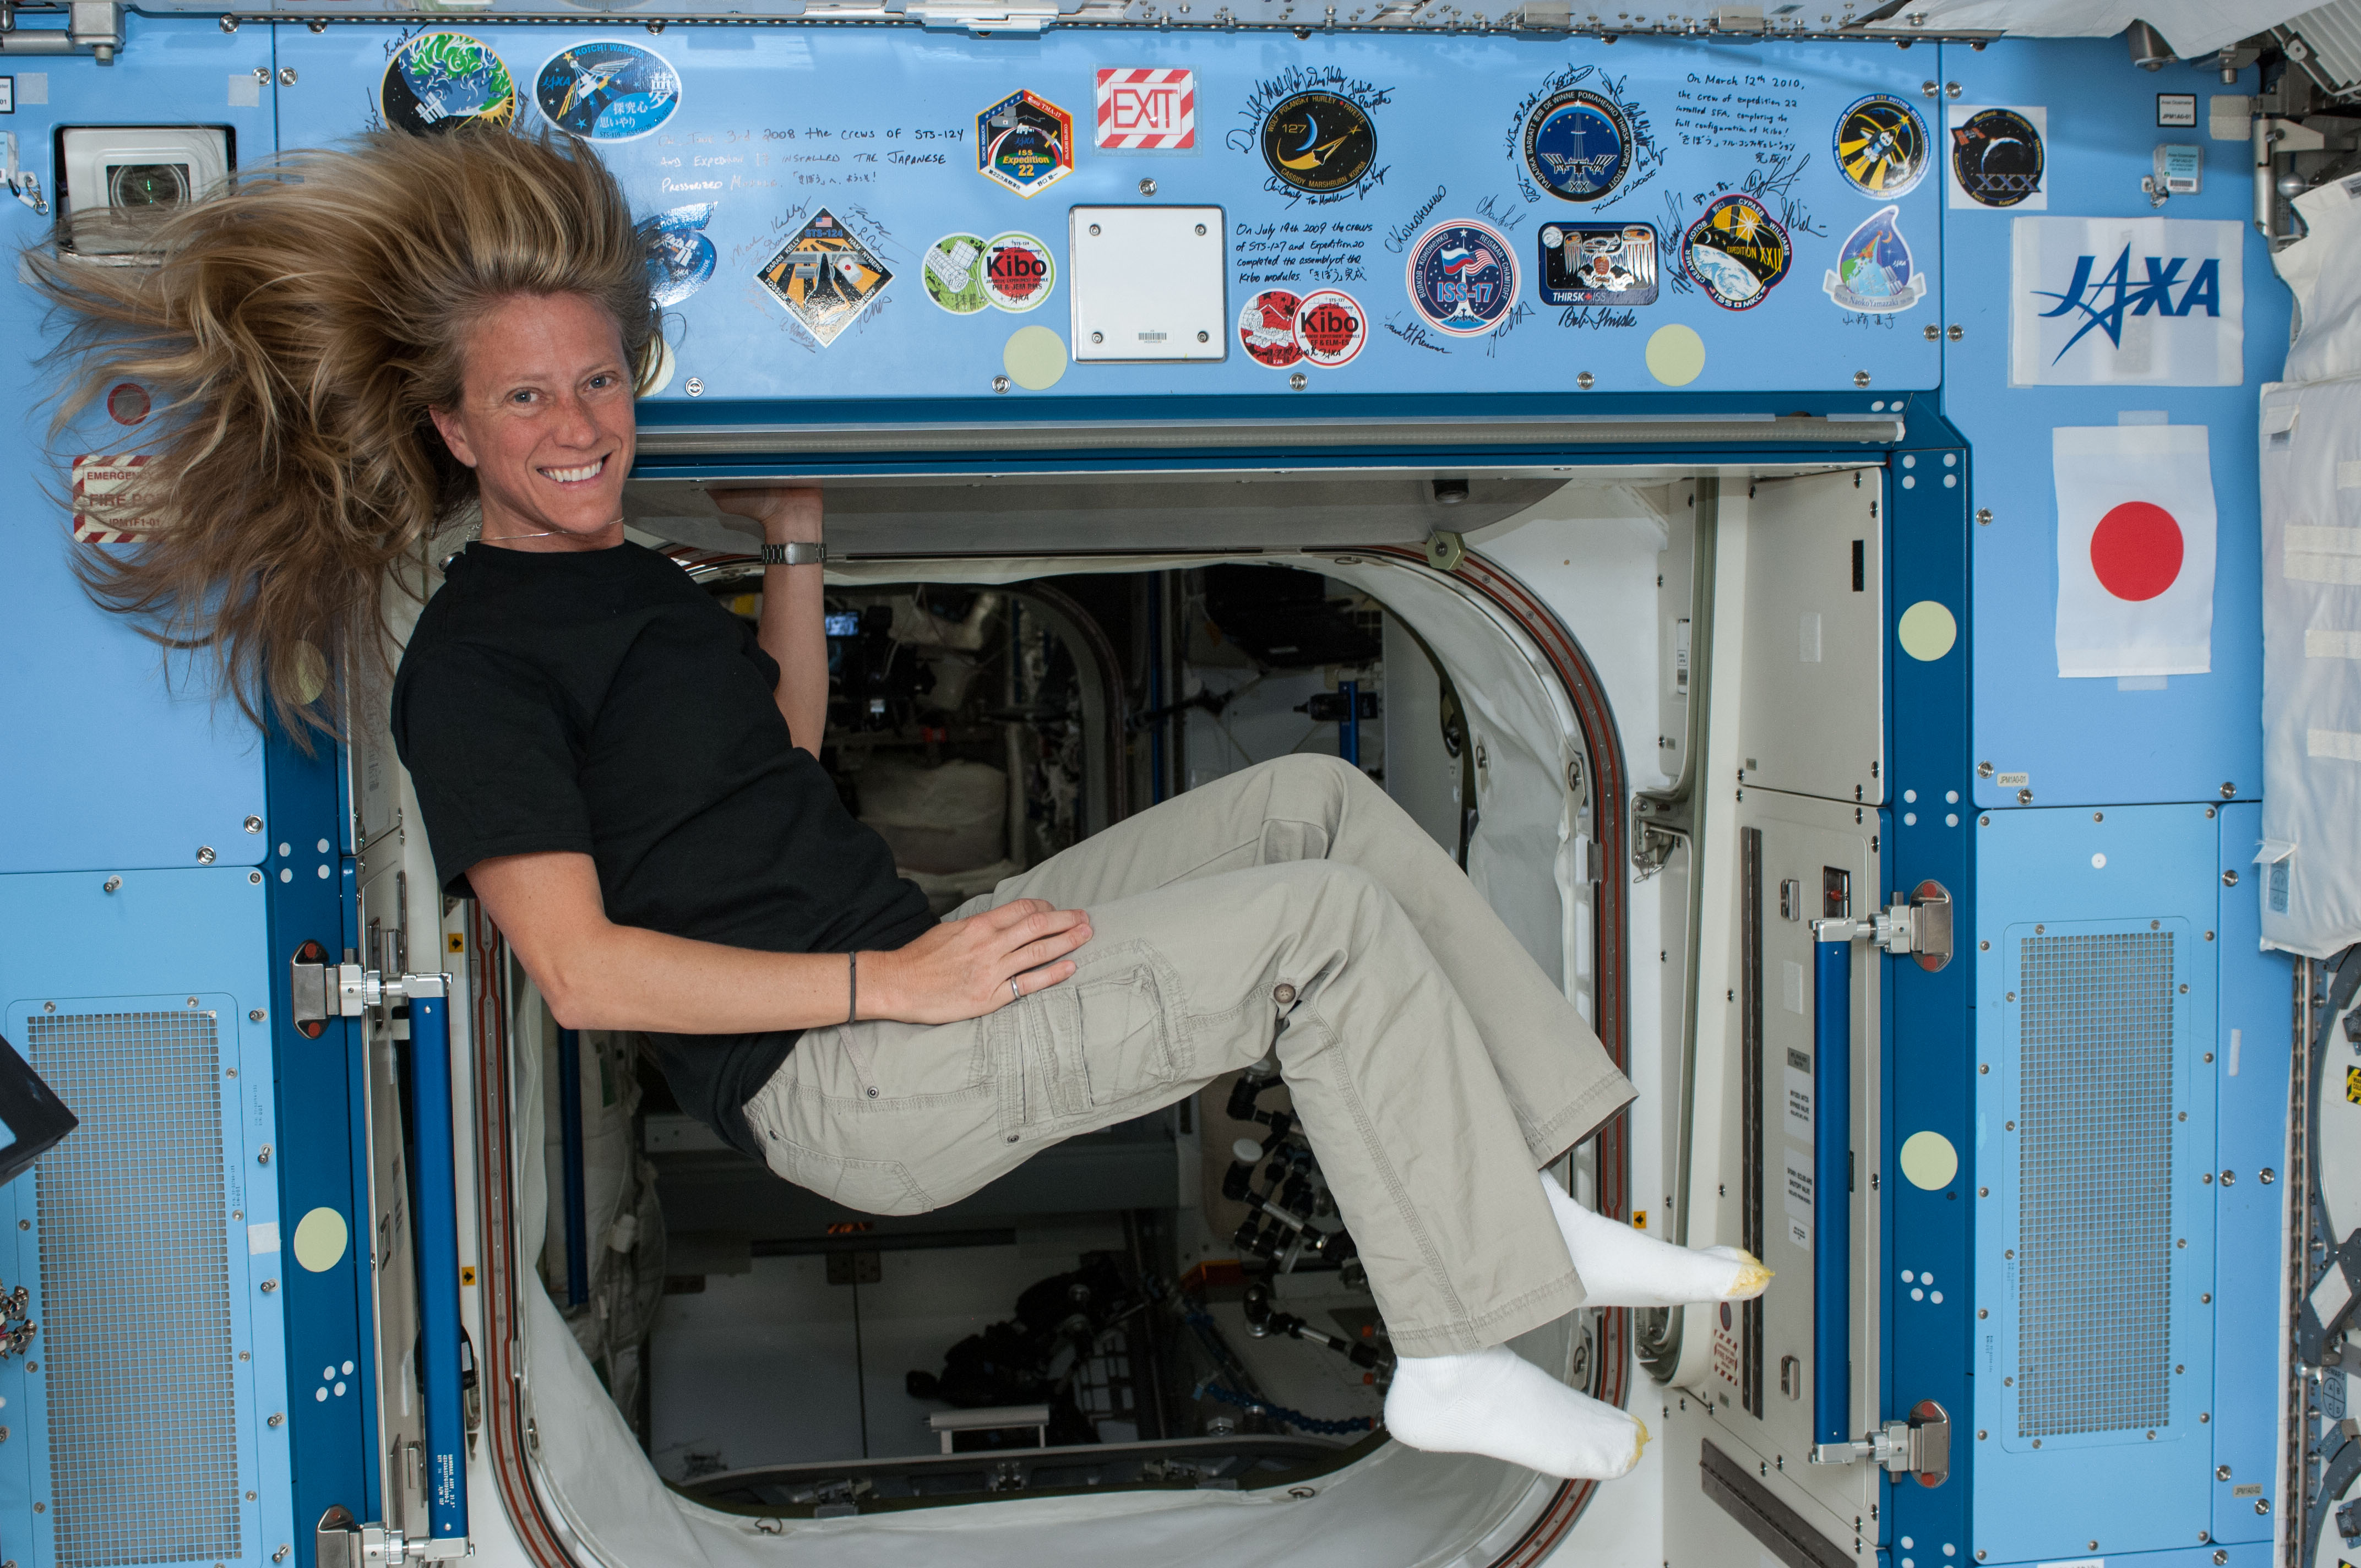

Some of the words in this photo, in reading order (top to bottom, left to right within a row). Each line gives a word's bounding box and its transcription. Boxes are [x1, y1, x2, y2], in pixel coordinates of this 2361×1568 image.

[575, 45, 607, 57] KOICHI
[610, 45, 644, 58] WAKATA
[540, 75, 570, 92] JAXA
[1687, 73, 1701, 83] On
[1705, 74, 1738, 86] March
[1744, 74, 1765, 86] 12th
[1772, 78, 1805, 90] 2010,
[613, 101, 648, 115] 探究心
[1543, 101, 1554, 110] DE
[1553, 92, 1575, 104] WINNE
[1578, 92, 1619, 116] РОМАНЕНКО
[1678, 90, 1690, 100] the
[1697, 94, 1718, 102] crew
[1722, 94, 1732, 102] of
[1737, 96, 1780, 108] expedition
[1889, 97, 1910, 109] DUTTON
[654, 108, 671, 124] STS-127
[1042, 103, 1062, 117] TMA-17
[1113, 89, 1178, 128] EXIT
[1267, 113, 1280, 132] WOLF
[1279, 96, 1309, 115] POLANSKY
[1313, 95, 1337, 105] HURLEY
[1343, 103, 1367, 124] PAYETTE
[600, 117, 635, 128] 思いやり
[1675, 118, 1690, 128] full
[1695, 122, 1747, 134] configuration
[1777, 113, 1788, 123] the
[763, 128, 795, 142] 2008
[805, 127, 832, 139] the
[1282, 124, 1307, 133] 127
[1617, 117, 1629, 141] THIRSK
[1527, 122, 1537, 155] BARRATT
[853, 153, 878, 162] THE
[887, 150, 946, 165] JAPANESE
[1003, 156, 1050, 165] Expedition
[1622, 144, 1630, 167] KOPRA
[1018, 164, 1035, 177] 22
[1281, 168, 1306, 185] CASSIDY
[1308, 176, 1348, 188] MARSHBURN
[1348, 161, 1367, 179] KOPRA
[1527, 157, 1552, 189] ПАДАЛКА
[1608, 169, 1624, 189] STOTT
[1569, 181, 1590, 192] XX
[1976, 173, 2038, 191] XXX
[805, 229, 843, 237] STS-124
[1236, 223, 1252, 236] On
[1255, 223, 1276, 240] July
[1280, 222, 1299, 233] 19th
[1303, 222, 1327, 234] 2009
[1331, 221, 1345, 232] the
[1345, 222, 1373, 232] crews
[1689, 221, 1707, 242] КОТОВ
[1769, 222, 1790, 256] WILLIAMS
[766, 255, 784, 273] GARAN
[785, 237, 801, 254] KELLY
[847, 237, 862, 252] HAM
[862, 251, 883, 273] NYBERG
[1236, 241, 1247, 252] of
[1249, 241, 1287, 252] STS-127
[1288, 242, 1304, 251] and
[1310, 238, 1352, 254] Expedition
[987, 255, 1047, 277] Kibo
[1237, 255, 1280, 269] completed
[1283, 256, 1296, 265] the
[1299, 253, 1334, 269] assembly
[1333, 254, 1346, 265] of
[1347, 255, 1361, 265] the
[1479, 234, 1504, 259] REISMAN
[1500, 262, 1511, 301] CHAMITOFF
[1685, 249, 1706, 283] CREAMER
[1727, 246, 1758, 259] EXPEDITION
[1760, 247, 1782, 273] XXII
[1239, 272, 1260, 284] Kibo
[1264, 272, 1301, 282] modules.
[1416, 270, 1426, 298] ВОЛКОВ
[765, 277, 788, 301] FOSSUM
[1437, 282, 1493, 303] ISS-17
[1553, 292, 1585, 302] THIRSK
[1593, 292, 1606, 302] ISS
[1714, 294, 1732, 307] ISS
[1849, 296, 1869, 307] Naoko
[1869, 298, 1898, 307] Yamazaki
[2030, 241, 2221, 367] JAXA
[1301, 311, 1359, 333] Kibo
